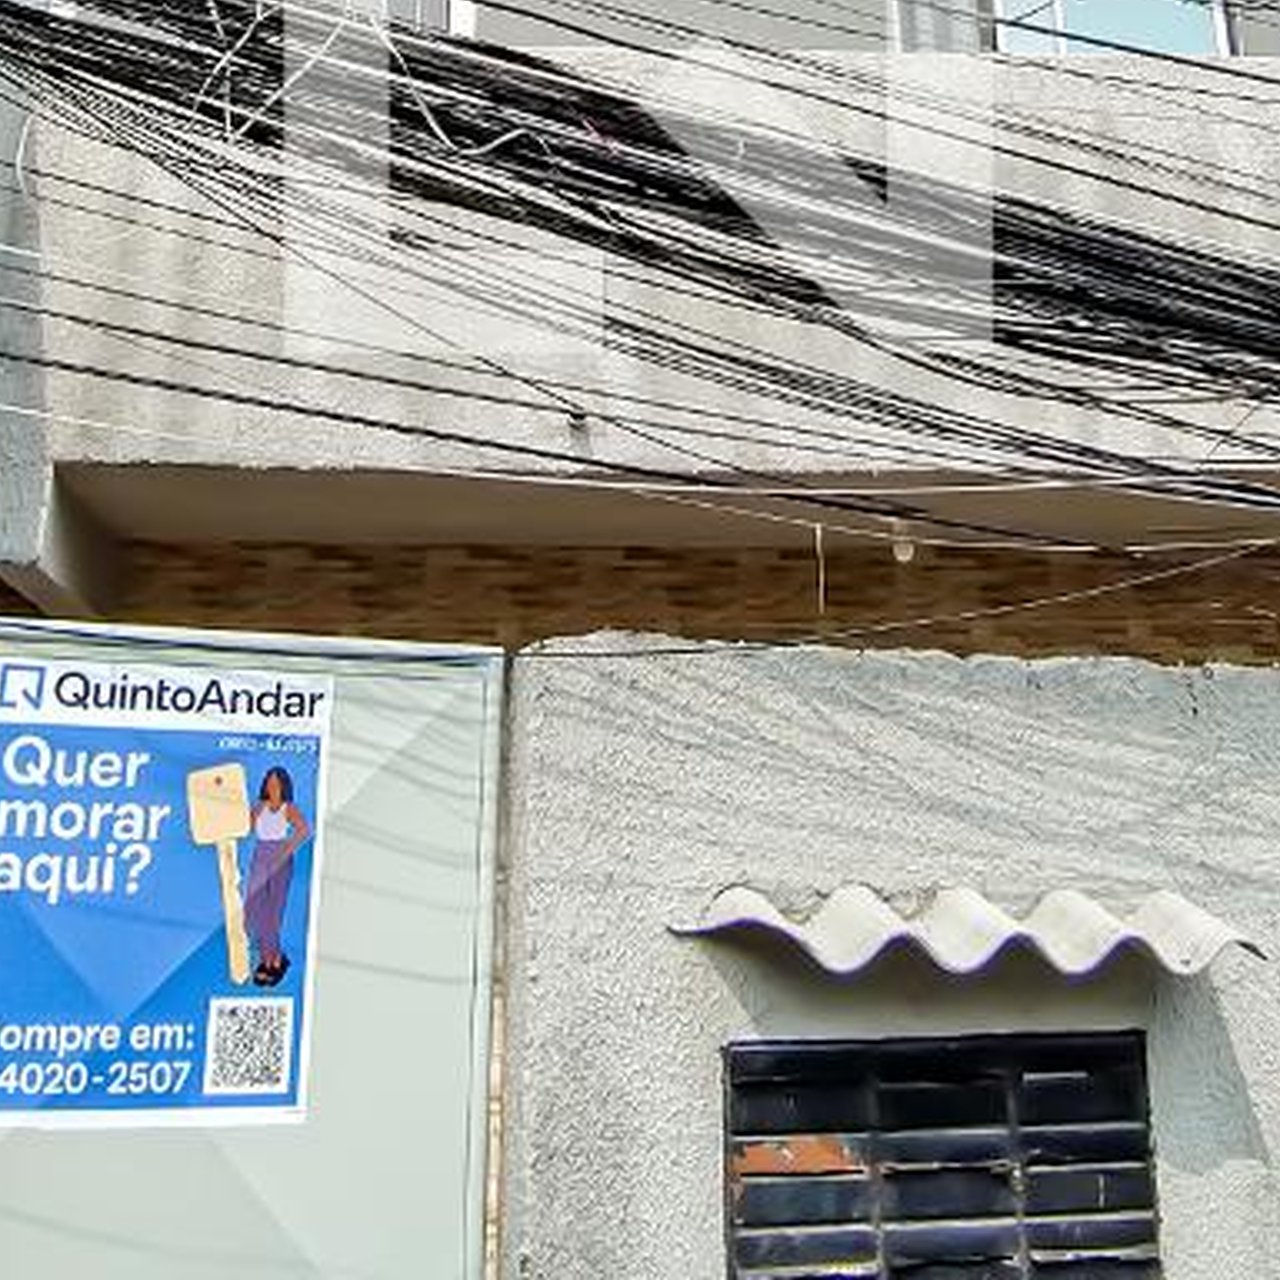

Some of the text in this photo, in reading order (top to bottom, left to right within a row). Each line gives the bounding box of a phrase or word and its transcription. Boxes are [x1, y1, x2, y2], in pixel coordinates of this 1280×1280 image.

[54, 672, 324, 718] QuintoAndar
[3, 736, 150, 788] Quer
[129, 1020, 195, 1052] em:
